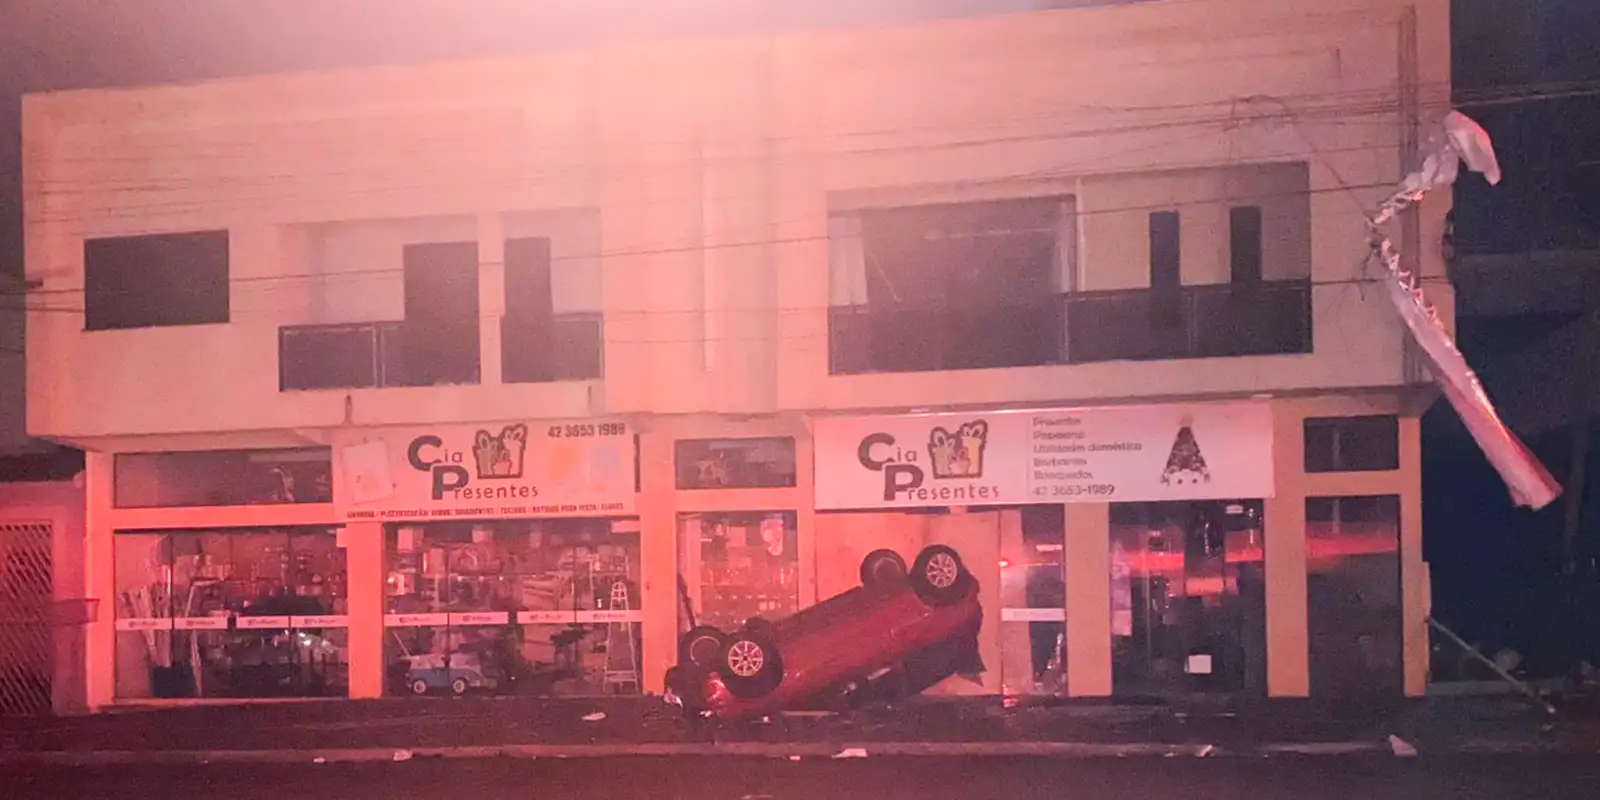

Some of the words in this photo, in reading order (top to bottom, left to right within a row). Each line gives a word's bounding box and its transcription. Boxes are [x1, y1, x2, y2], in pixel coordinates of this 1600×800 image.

[548, 426, 562, 438] 42
[564, 424, 595, 438] 3653
[407, 434, 463, 472] Cia
[857, 432, 917, 471] Cia
[432, 464, 538, 501] Presentes
[884, 464, 1000, 501] Presentes
